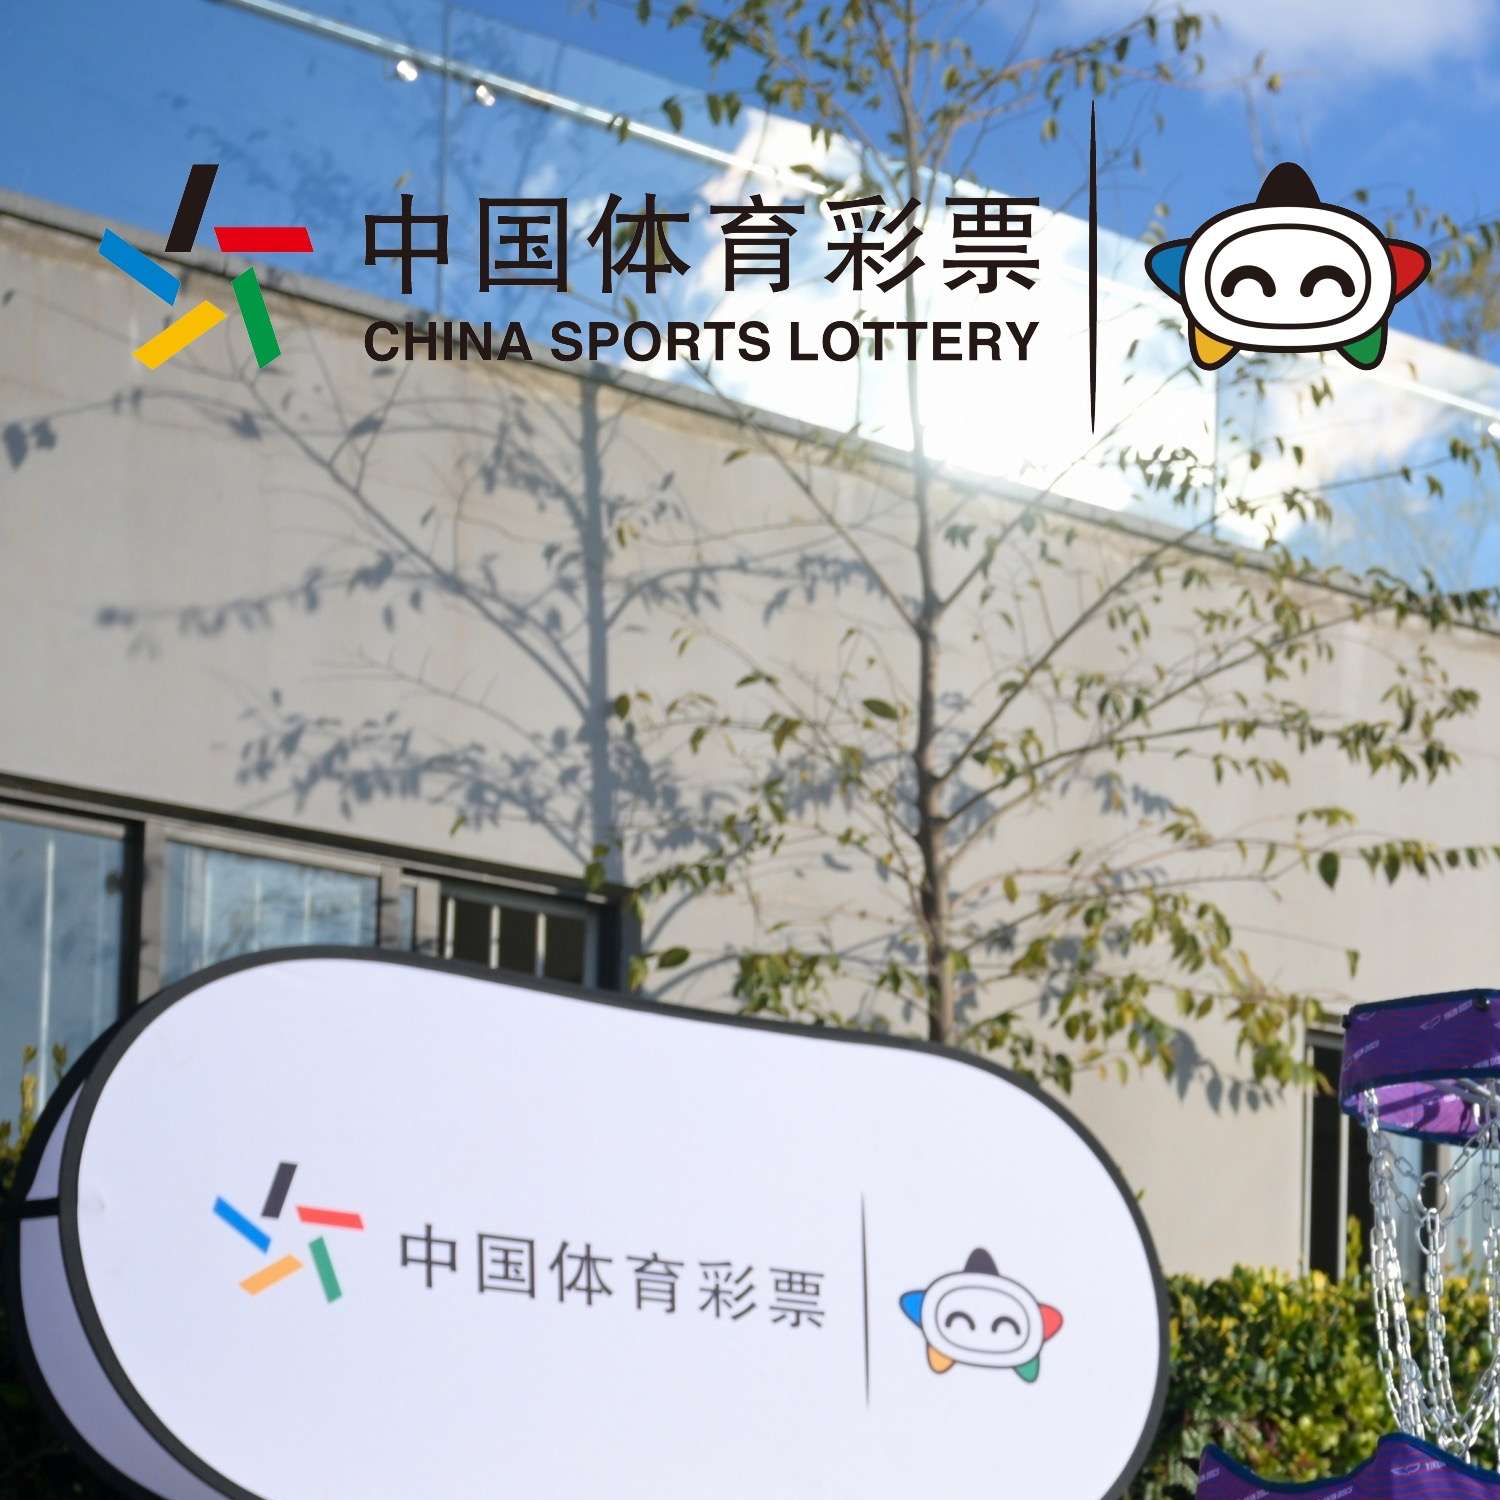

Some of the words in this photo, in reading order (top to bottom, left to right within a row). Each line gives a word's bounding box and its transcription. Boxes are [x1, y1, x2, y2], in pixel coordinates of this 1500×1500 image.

[398, 1223, 826, 1330] 中国体育彩票
